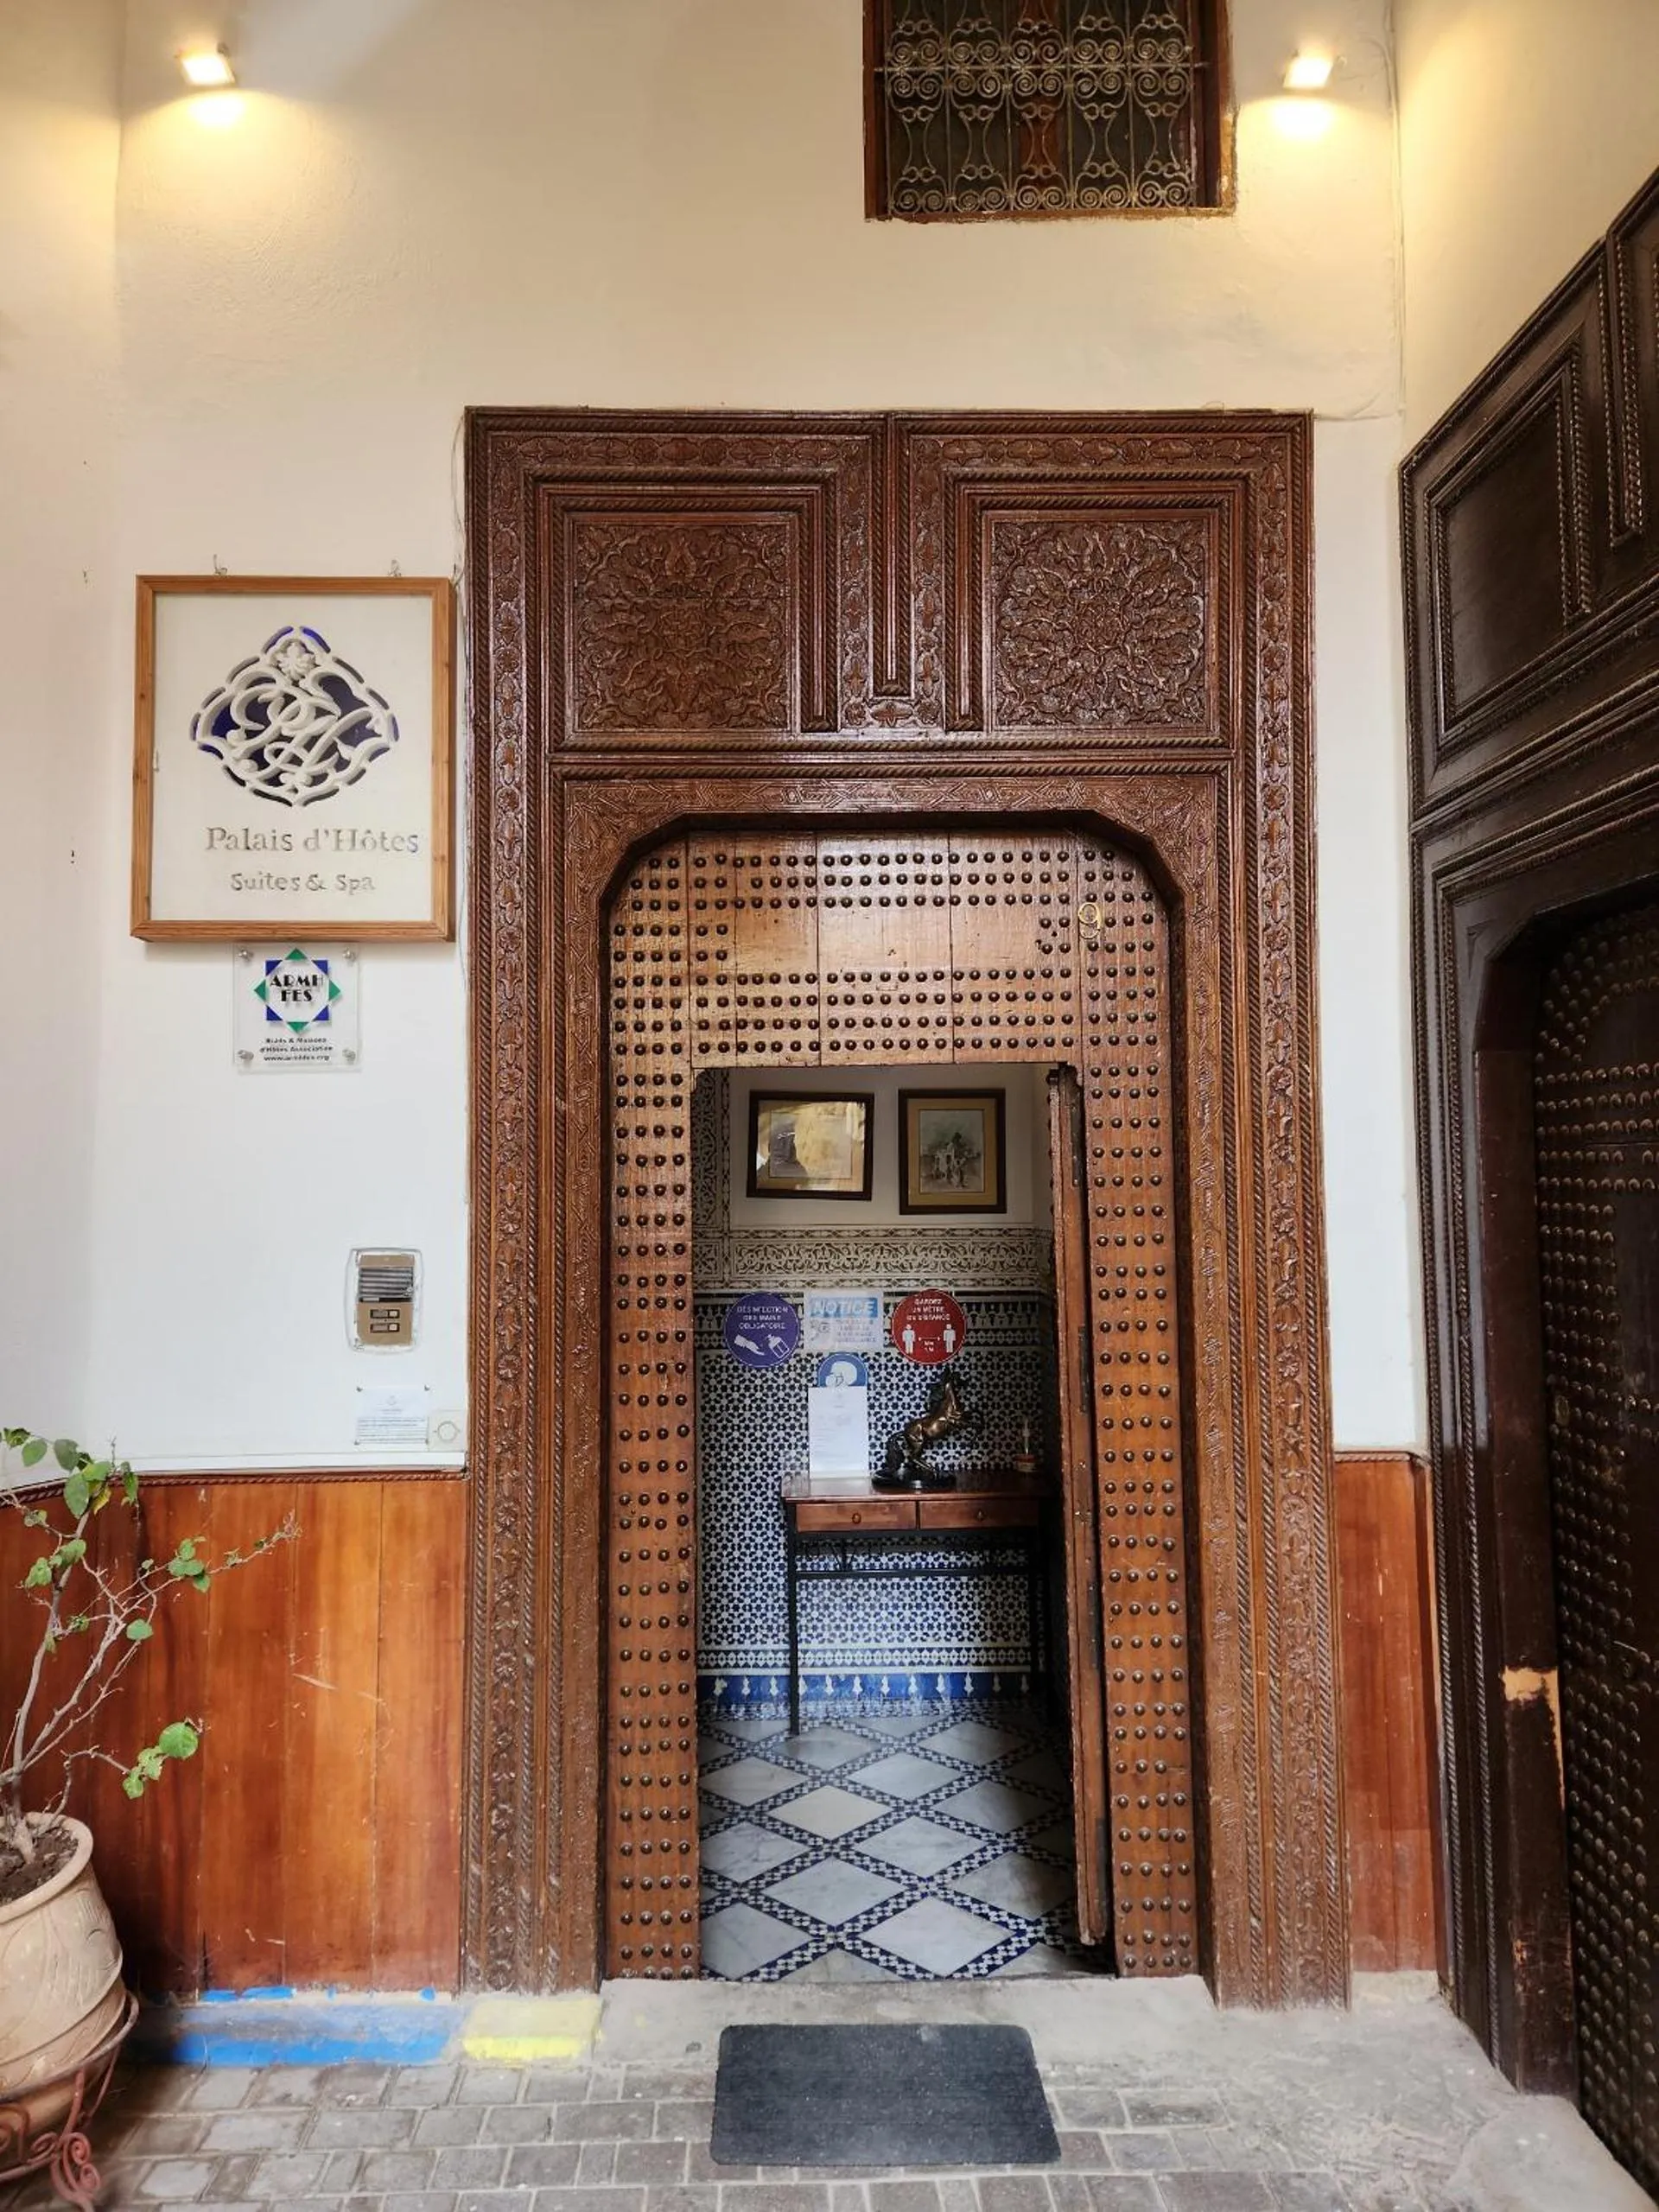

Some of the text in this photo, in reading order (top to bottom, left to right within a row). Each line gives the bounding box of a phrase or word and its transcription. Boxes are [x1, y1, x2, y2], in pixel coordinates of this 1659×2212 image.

[206, 826, 420, 853] Palais d'Hôtes
[230, 871, 376, 895] Suites & Spa
[1077, 902, 1102, 939] 9
[270, 974, 324, 987] ARMH
[281, 988, 313, 1001] FES
[810, 1299, 874, 1315] NOTICE
